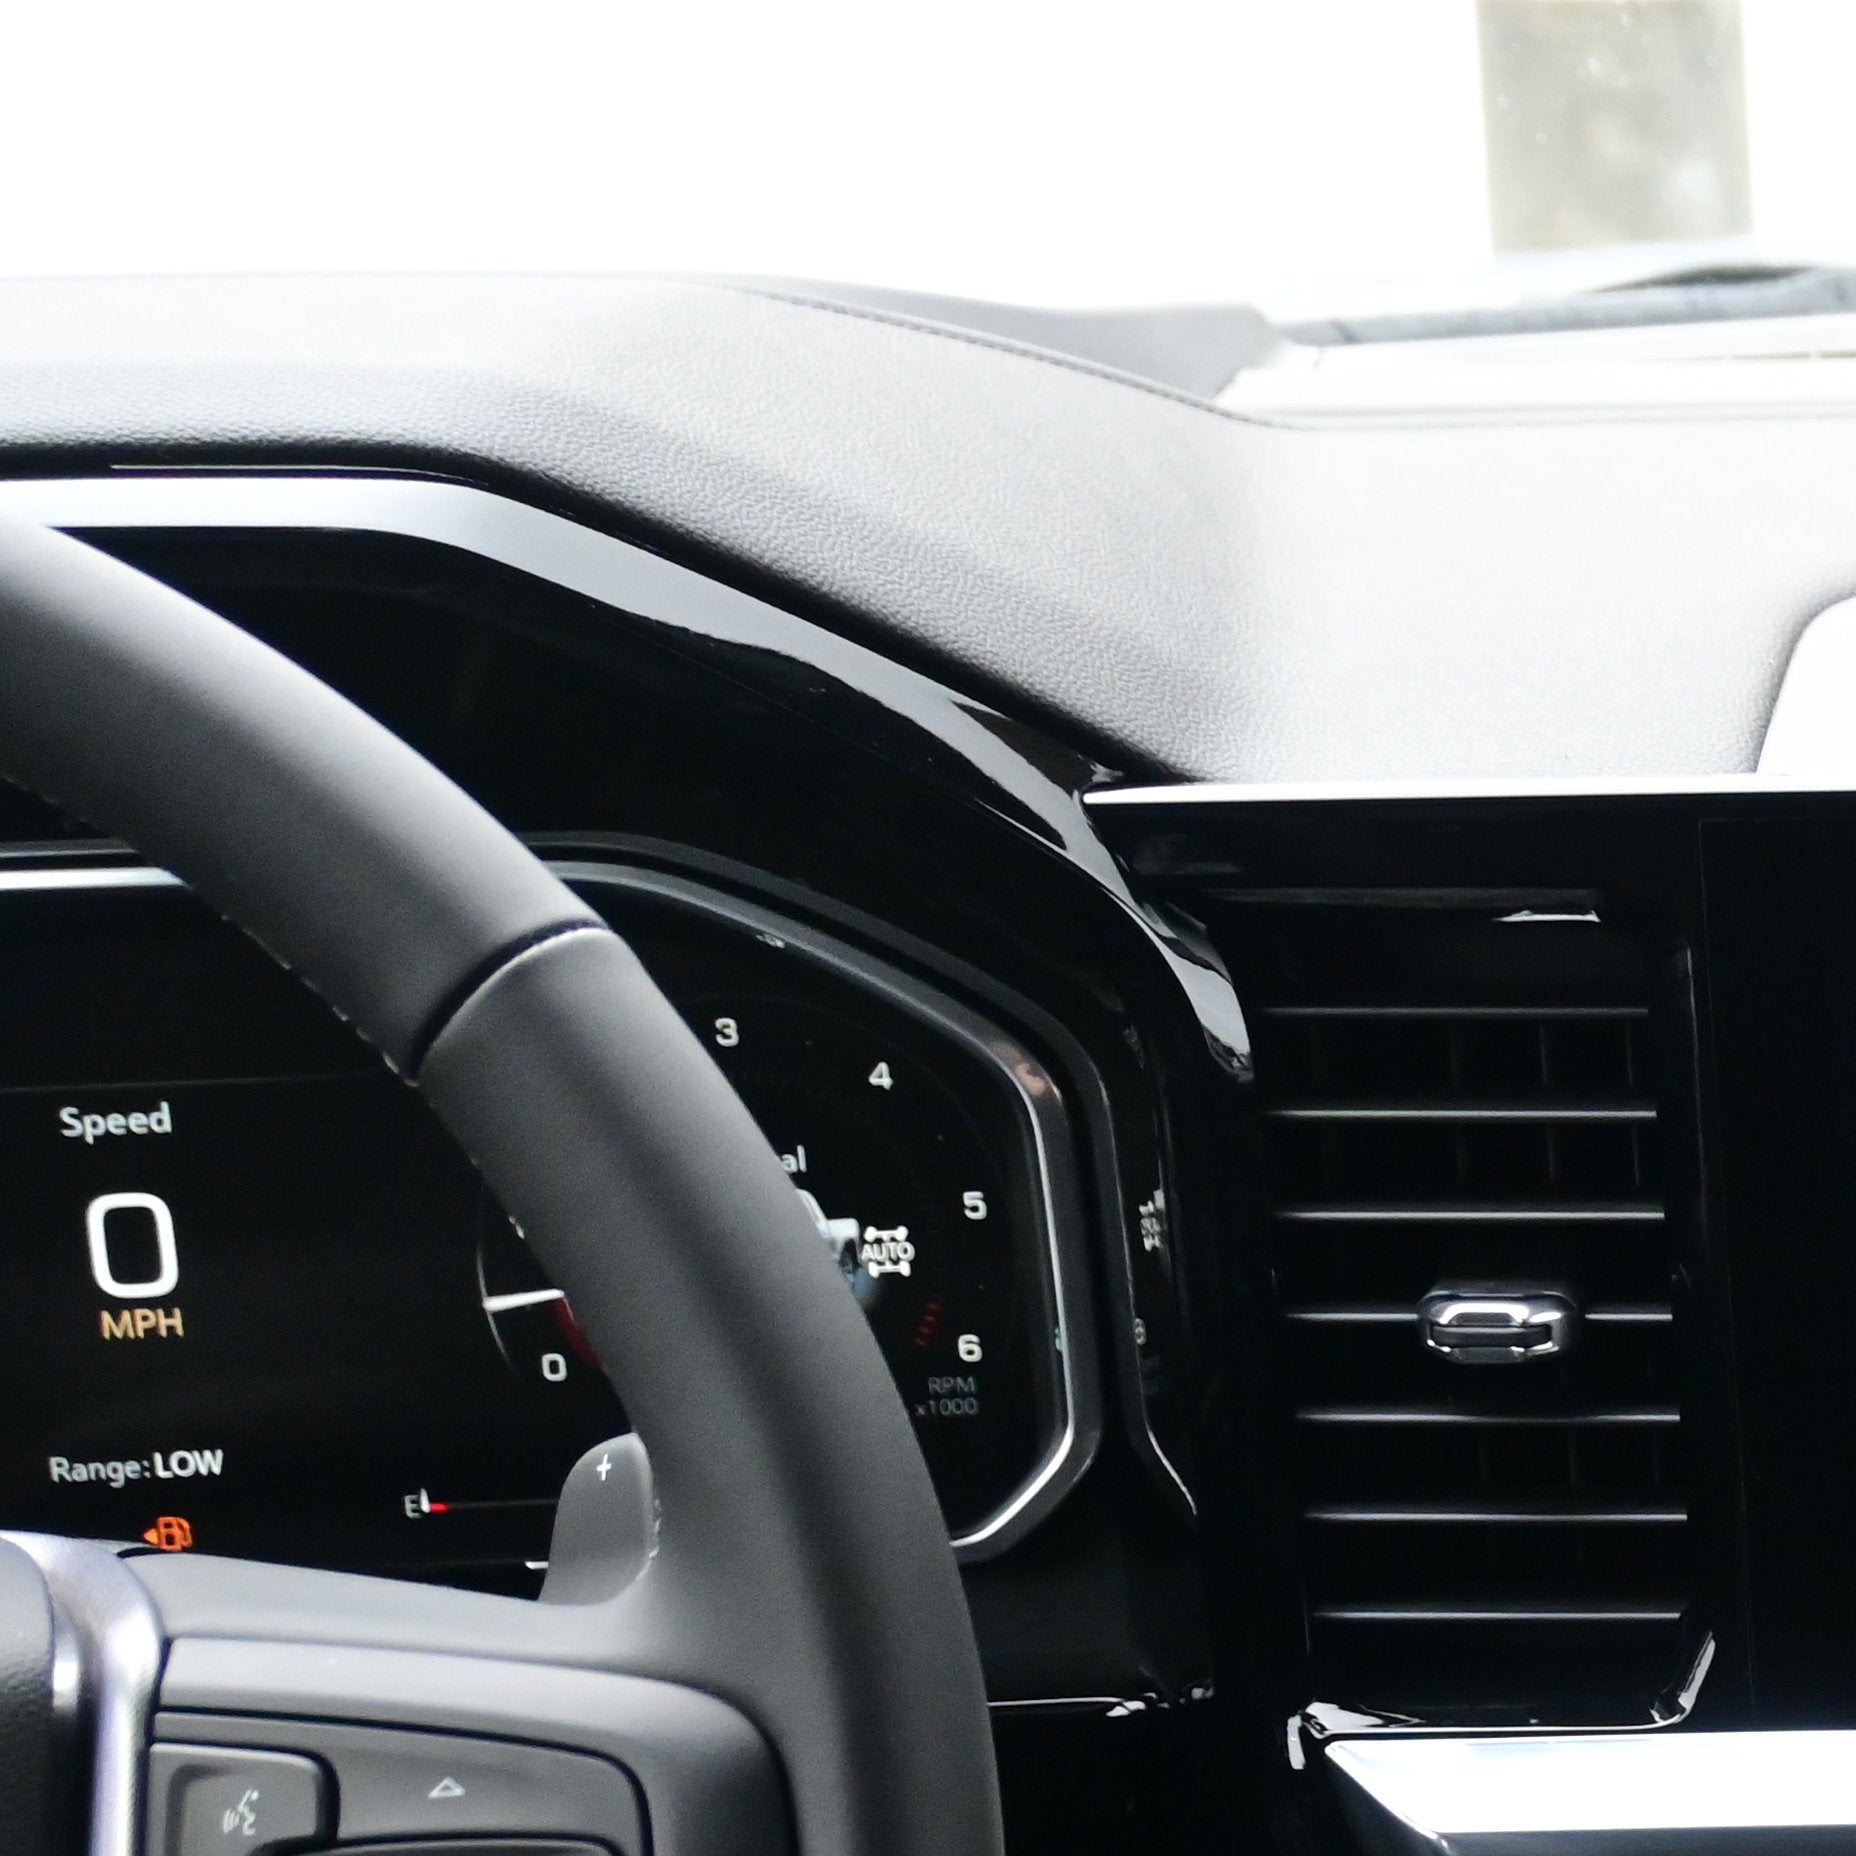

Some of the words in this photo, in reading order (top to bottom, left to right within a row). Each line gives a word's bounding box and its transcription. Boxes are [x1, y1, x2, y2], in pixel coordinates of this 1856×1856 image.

[714, 1017, 739, 1047] 3
[868, 1061, 893, 1090] 4
[59, 1101, 172, 1145] Speed
[962, 1191, 987, 1220] 5
[86, 1192, 179, 1299] 0
[861, 1240, 915, 1262] AUTO
[100, 1307, 184, 1340] MPH
[957, 1334, 982, 1362] 6
[541, 1353, 567, 1382] 0
[928, 1376, 975, 1394] RPM
[49, 1456, 151, 1488] Range:
[153, 1449, 224, 1479] LOW
[404, 1495, 419, 1518] E
